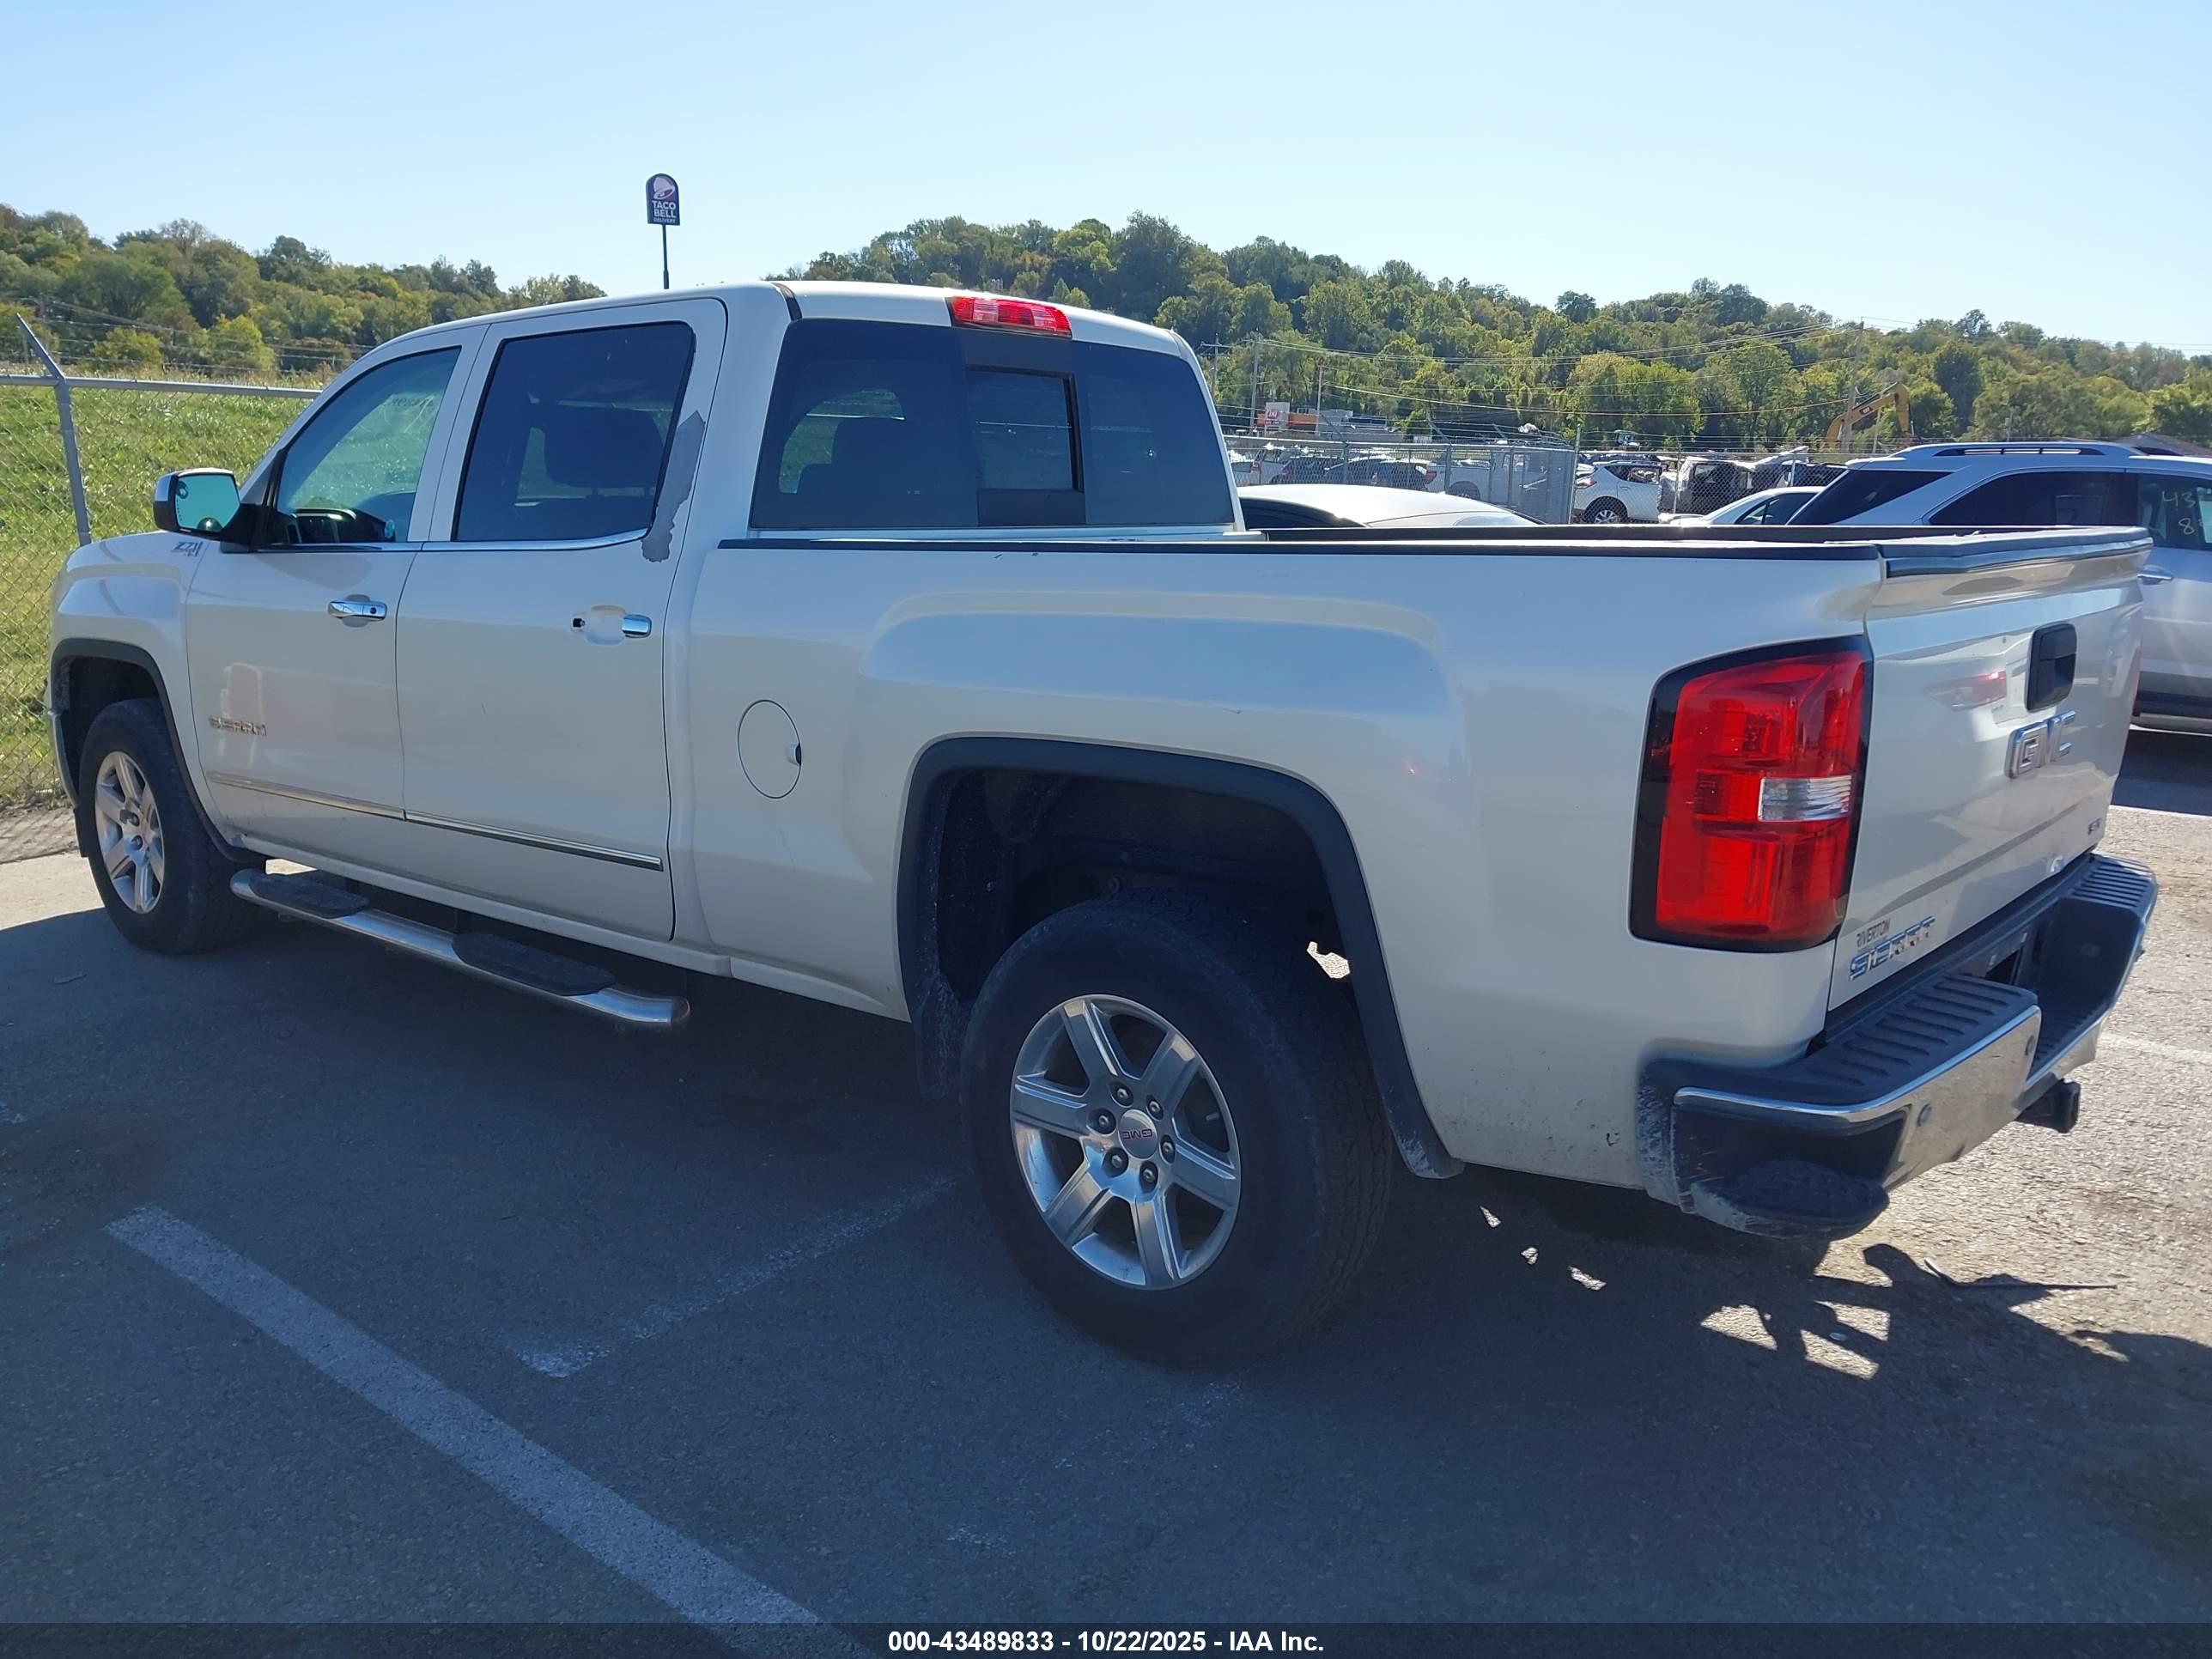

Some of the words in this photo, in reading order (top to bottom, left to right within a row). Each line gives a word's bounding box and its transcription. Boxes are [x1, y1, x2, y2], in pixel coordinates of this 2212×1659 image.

[652, 200, 677, 210] TACO
[653, 209, 677, 218] BELL
[1856, 919, 1891, 947] RIVERTON
[1121, 1128, 1153, 1139] GMC
